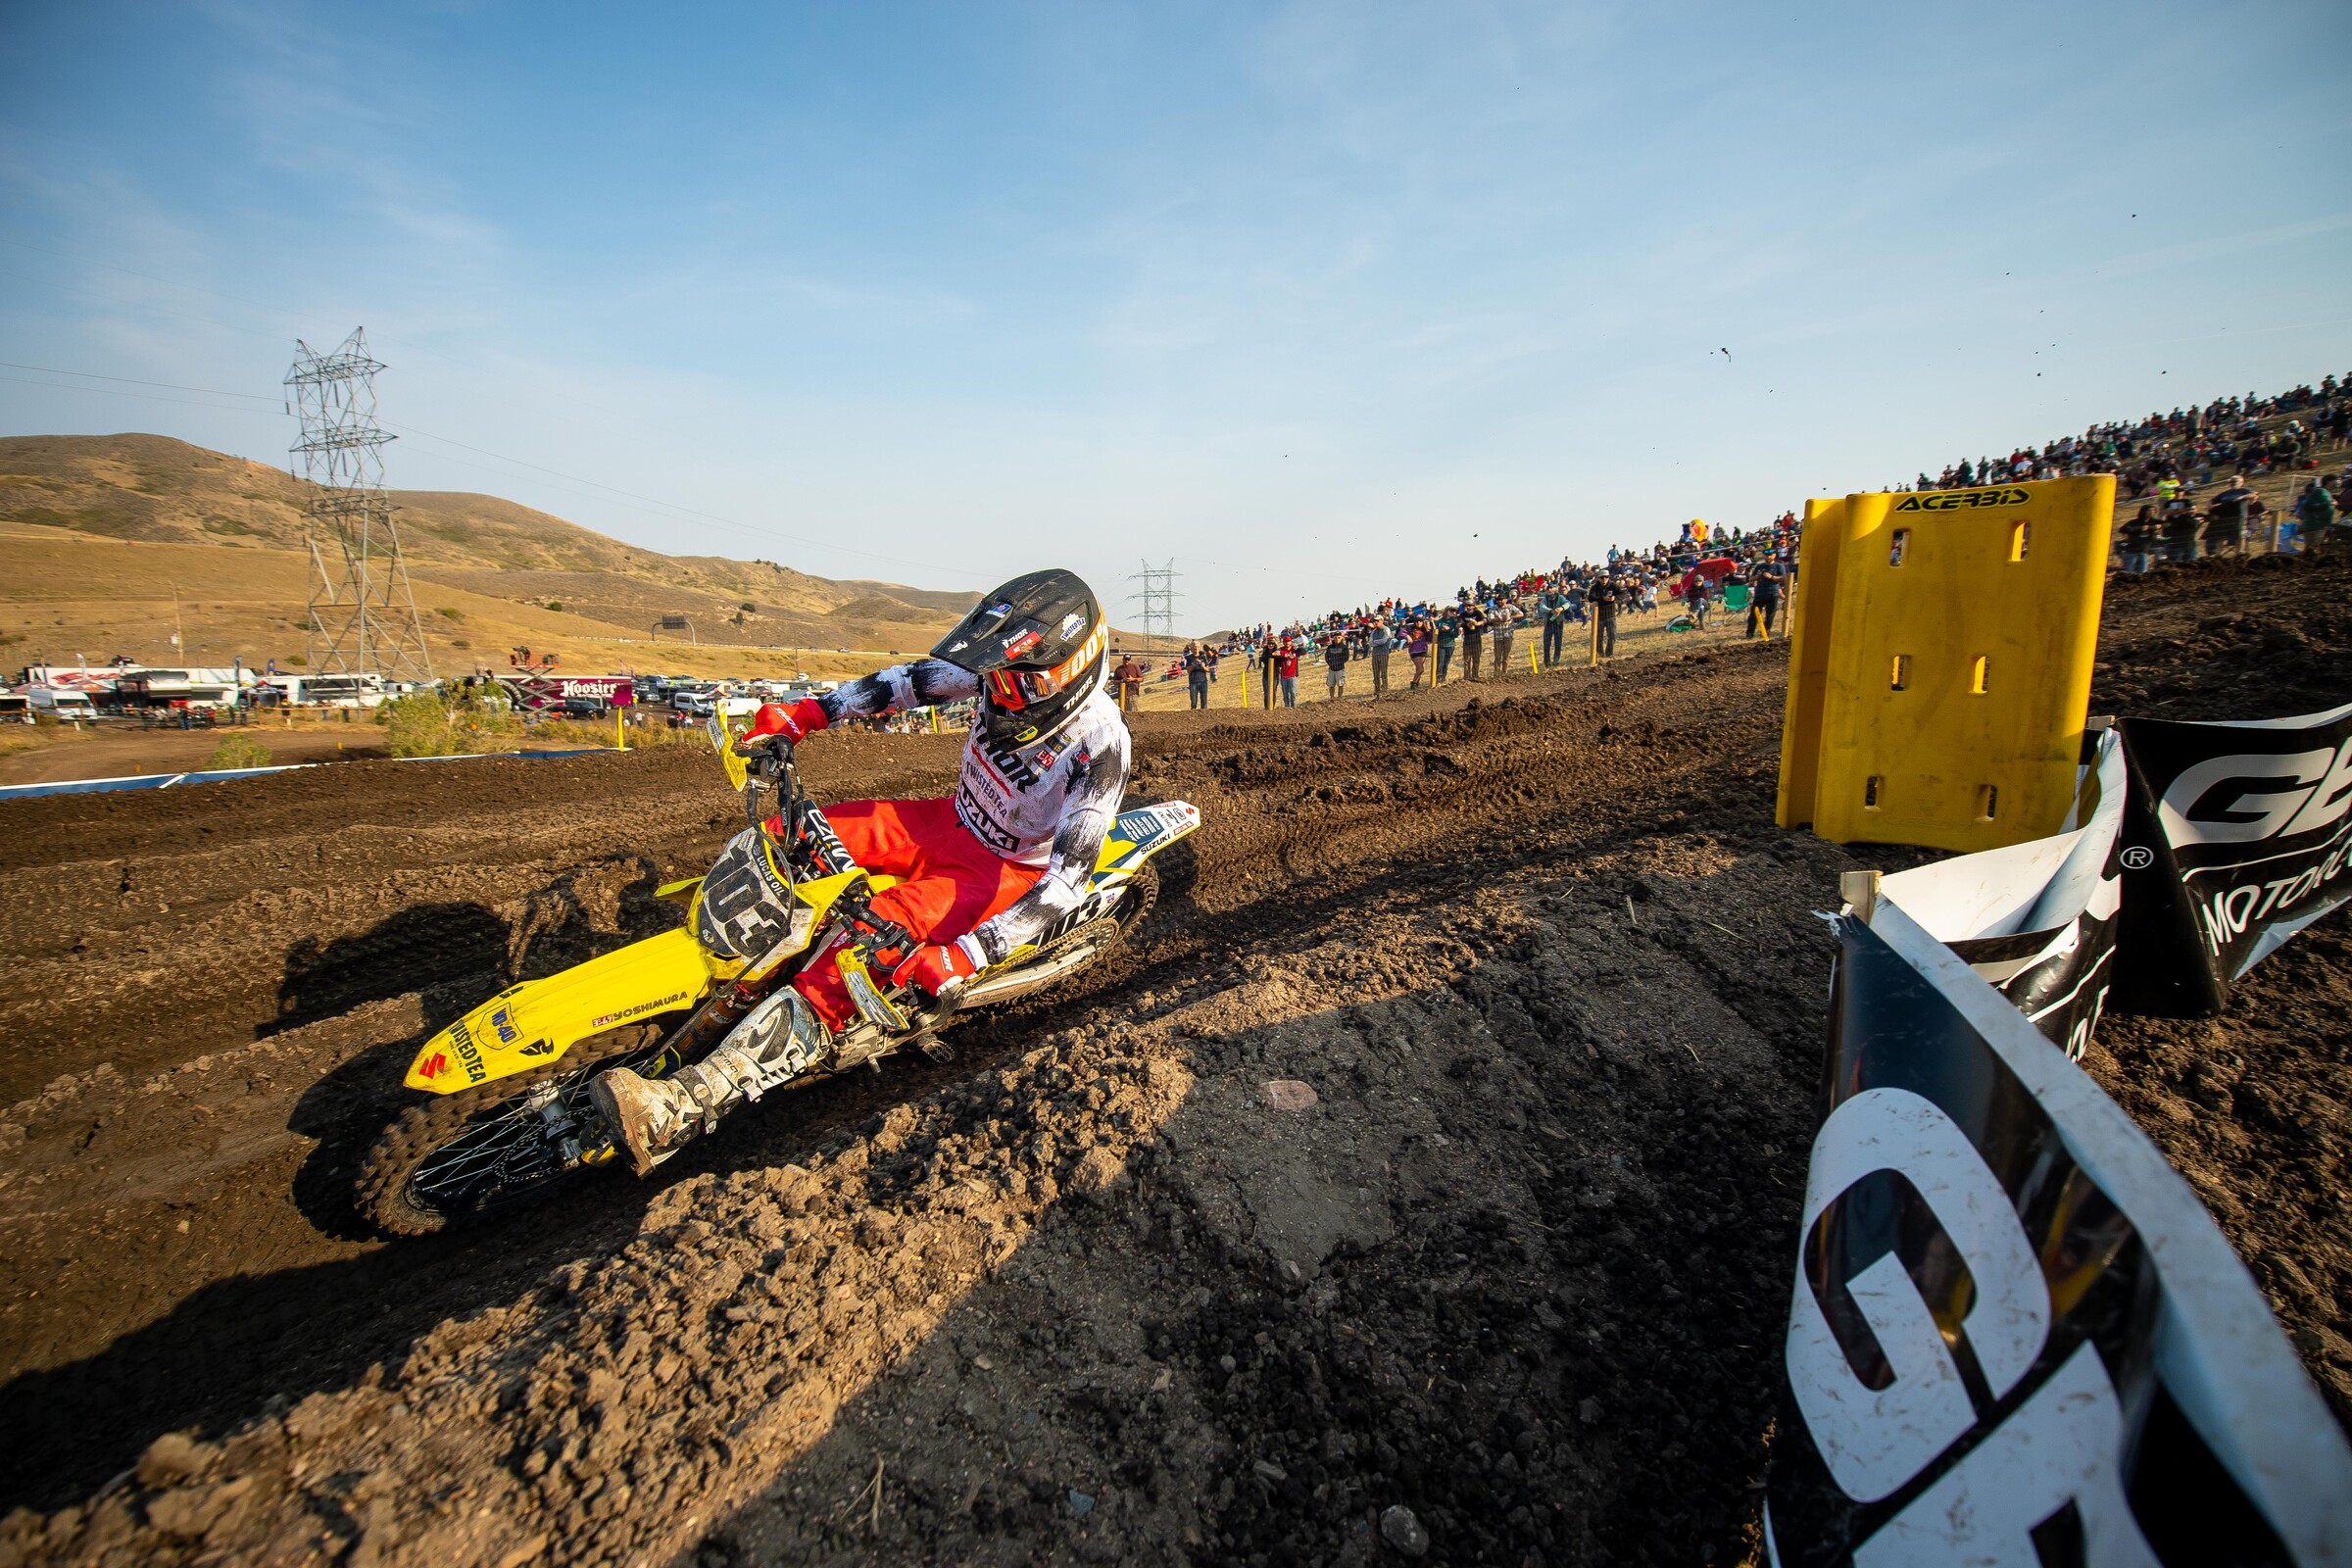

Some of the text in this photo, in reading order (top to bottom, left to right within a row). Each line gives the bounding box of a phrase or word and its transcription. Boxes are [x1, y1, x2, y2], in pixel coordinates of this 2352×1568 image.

[1008, 628, 1029, 646] THOR
[1061, 616, 1086, 641] TWISTED TEA
[560, 679, 617, 697] Hoosier
[1063, 674, 1094, 710] THOR
[965, 760, 996, 802] TWISTED
[993, 795, 1007, 818] TEA
[1140, 833, 1171, 855] SUZUKI
[757, 856, 785, 897] LUCAS OIL
[613, 991, 688, 1021] YOSHIMURA
[491, 1007, 516, 1043] WD-40
[466, 1055, 487, 1083] TEA
